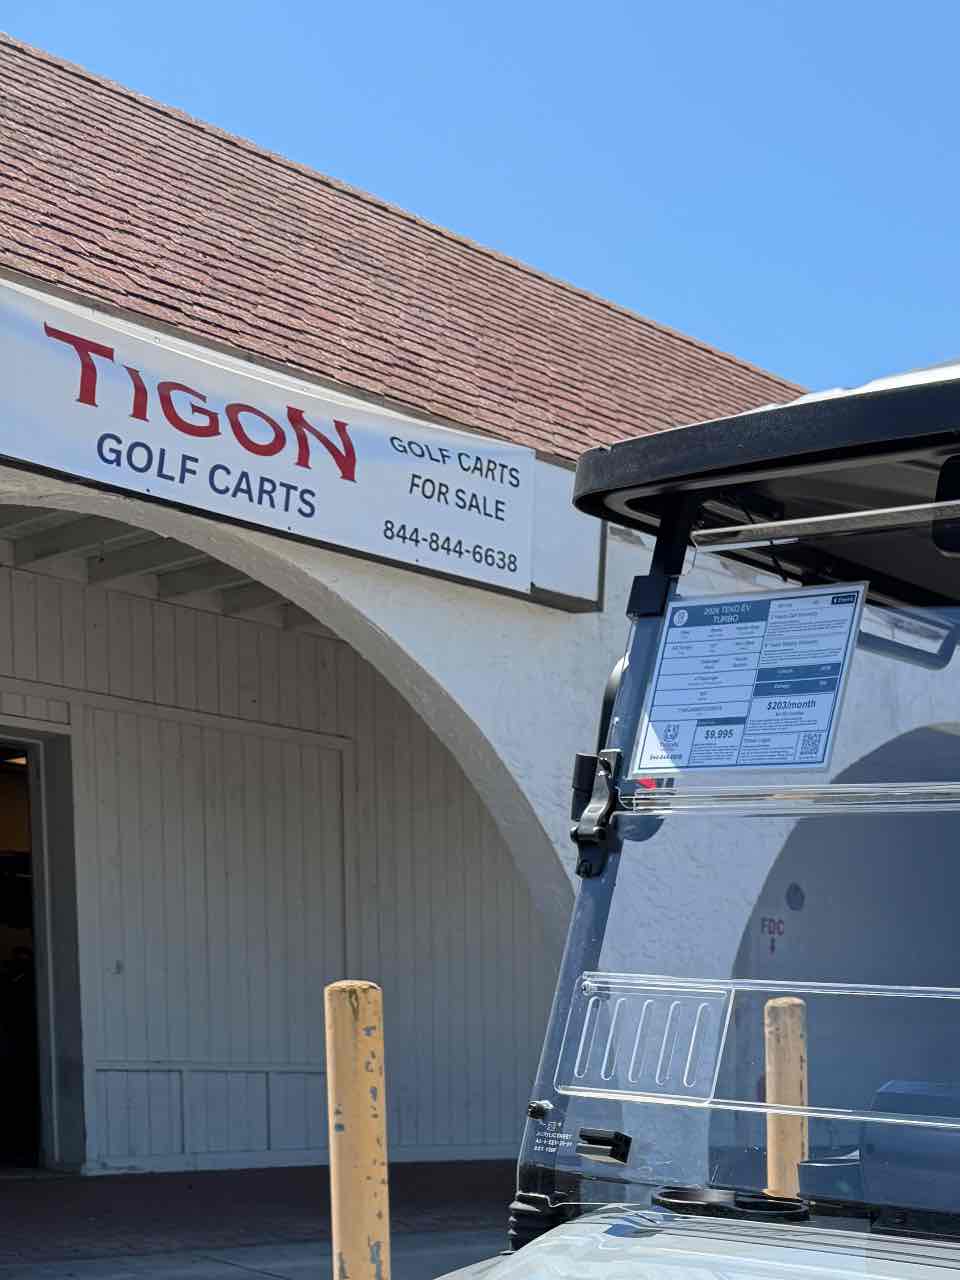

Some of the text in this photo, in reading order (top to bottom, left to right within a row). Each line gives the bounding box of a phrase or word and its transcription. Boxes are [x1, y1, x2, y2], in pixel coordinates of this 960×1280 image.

[43, 321, 357, 483] TIGON
[96, 432, 316, 519] GOLF CARTS
[389, 436, 521, 488] GOLF CARTS
[409, 474, 506, 522] FOR SALE
[383, 519, 518, 573] 844-844-6638
[767, 699, 816, 711] $203/month
